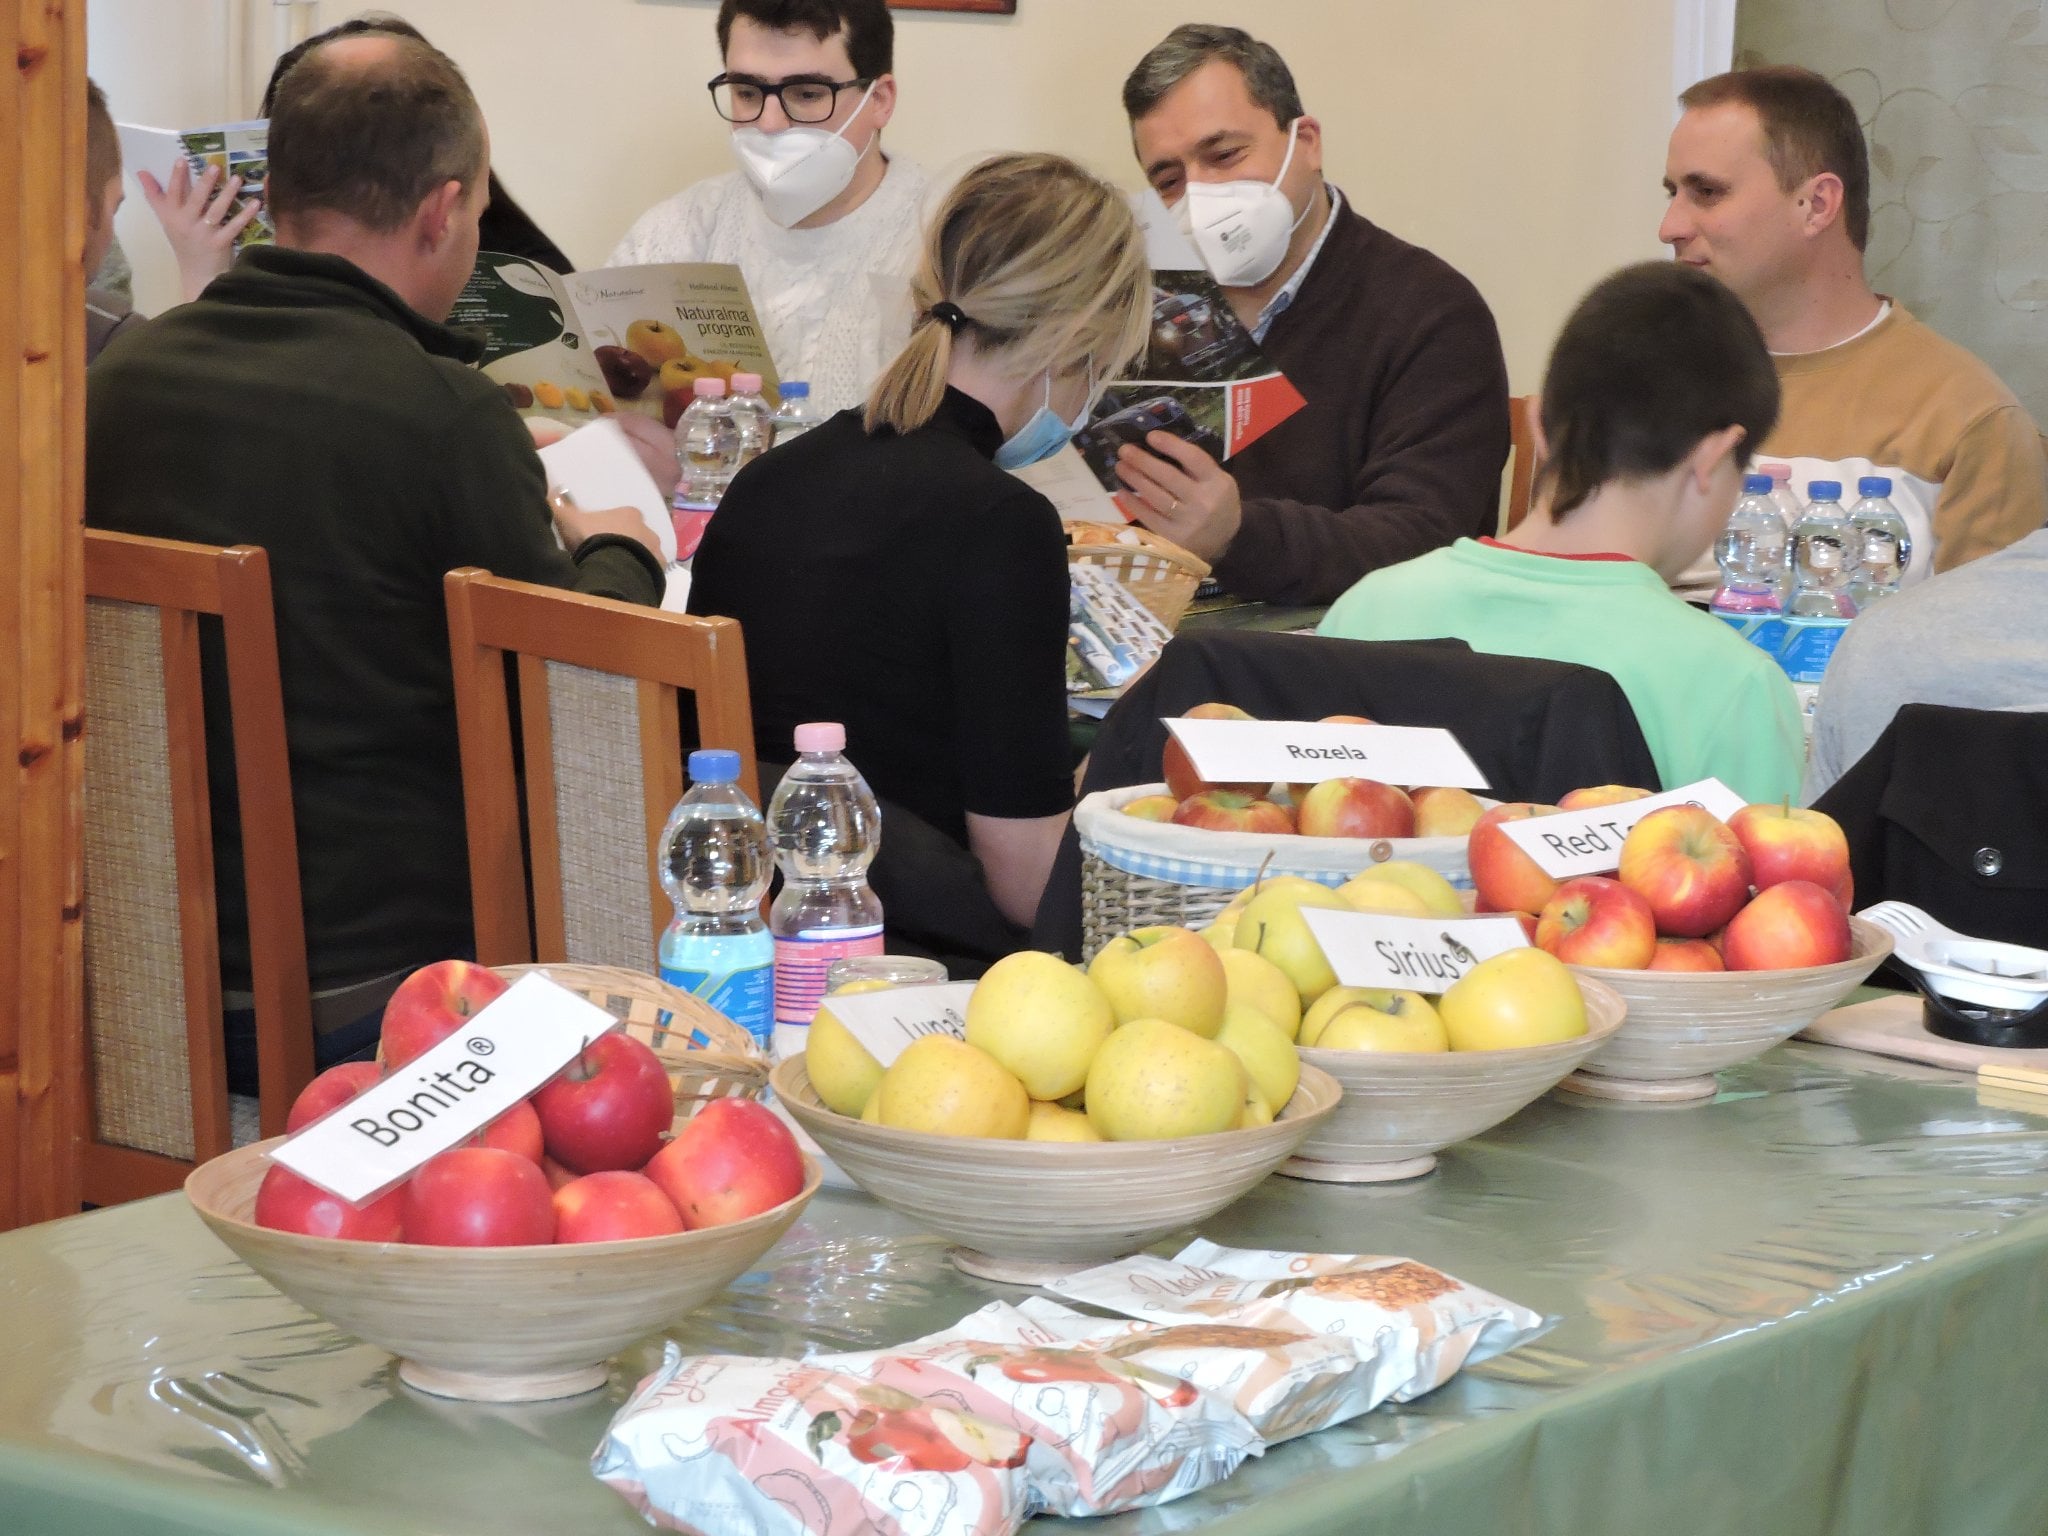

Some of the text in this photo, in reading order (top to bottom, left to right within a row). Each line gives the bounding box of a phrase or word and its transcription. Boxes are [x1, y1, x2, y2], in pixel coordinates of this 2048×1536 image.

[675, 306, 751, 322] Naturalma
[697, 323, 756, 338] program
[1286, 744, 1368, 760] Rozela
[1541, 825, 1612, 858] Red
